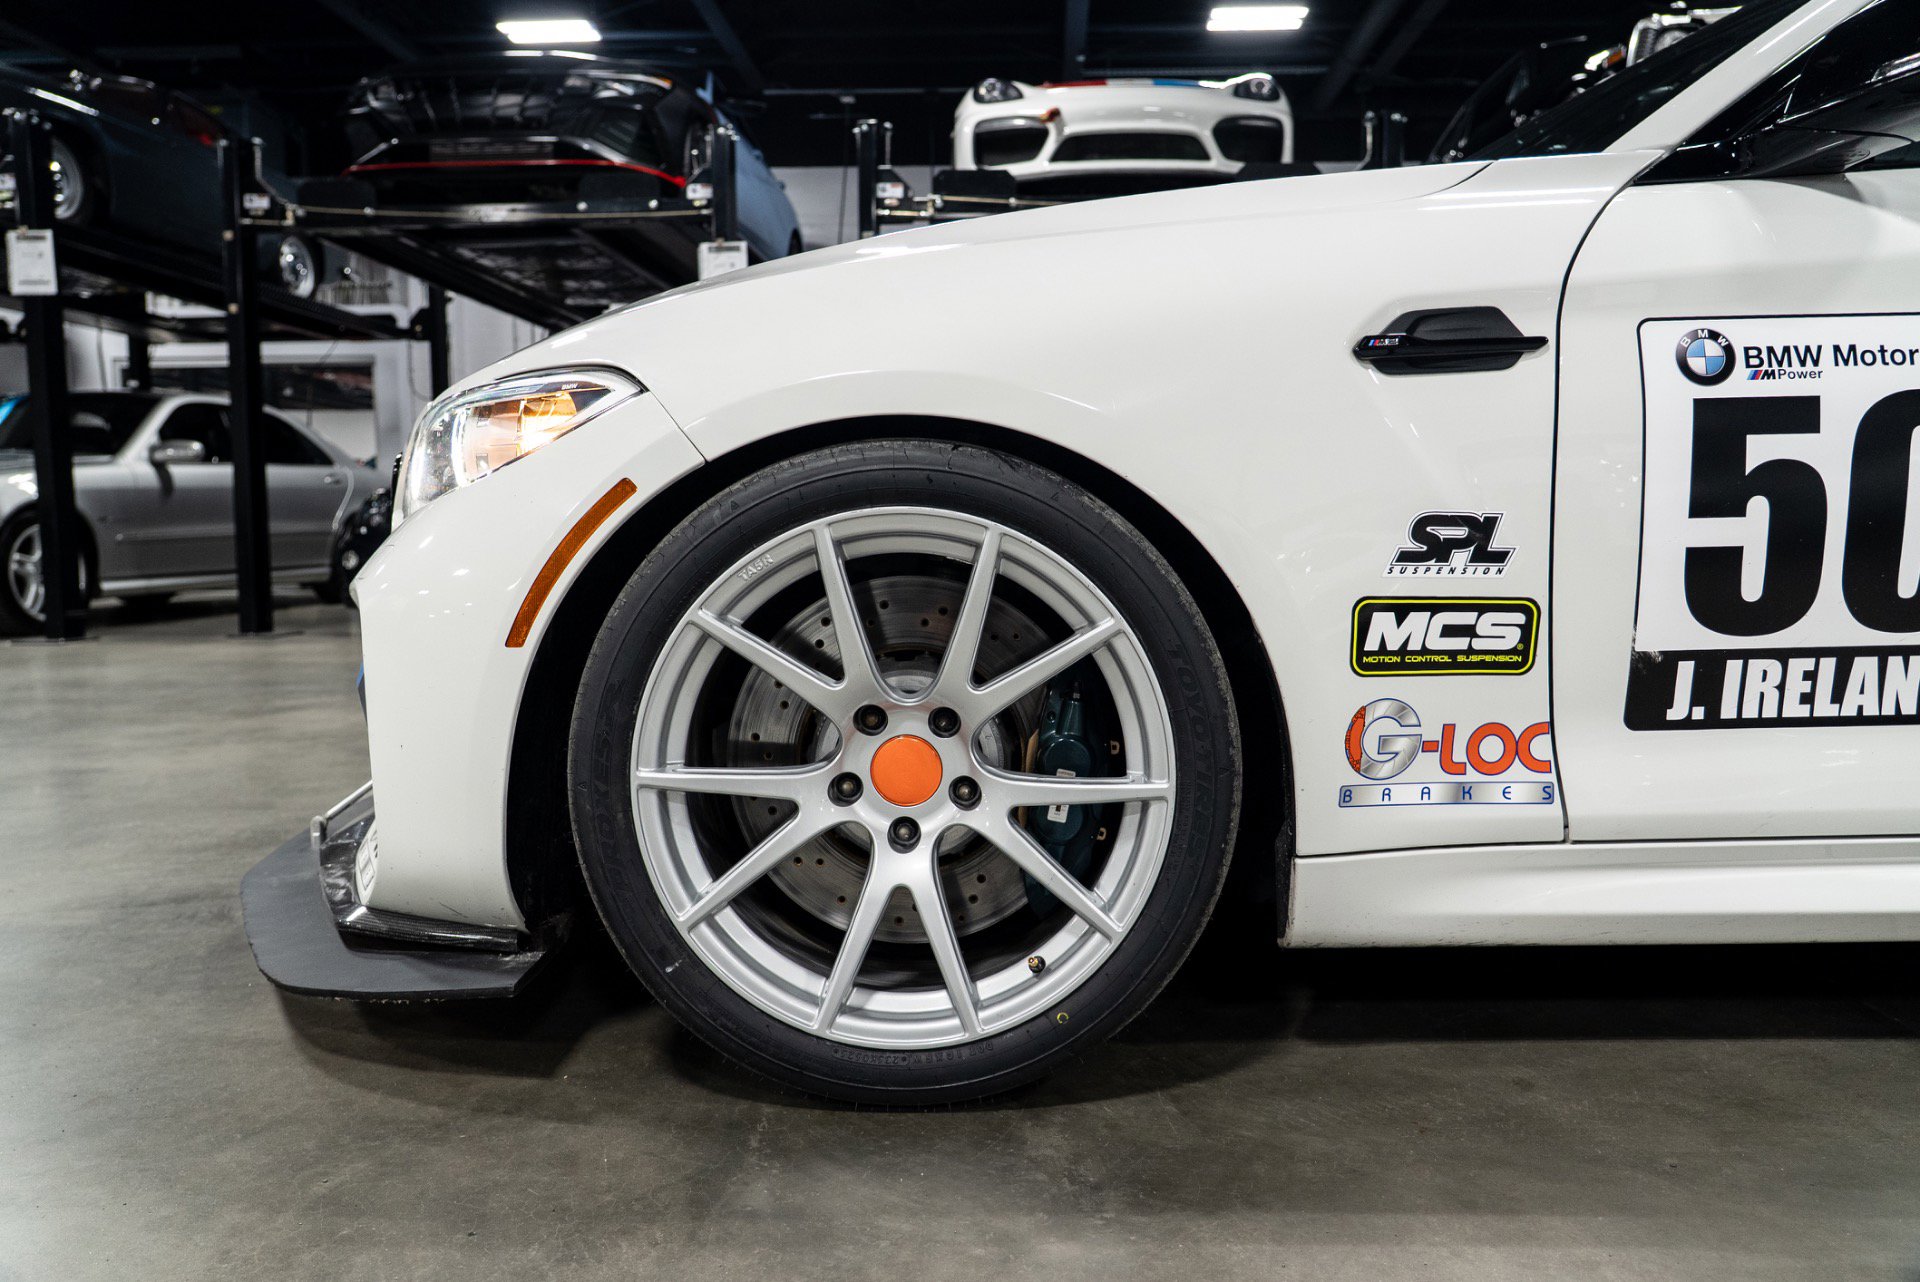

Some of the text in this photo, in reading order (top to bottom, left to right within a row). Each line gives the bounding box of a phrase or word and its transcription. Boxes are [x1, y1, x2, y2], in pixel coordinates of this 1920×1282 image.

[1681, 329, 1728, 347] BMW
[1743, 344, 1919, 369] BMW Motor
[1390, 511, 1516, 566] SPL
[1387, 566, 1504, 575] SUSPENSION
[1363, 611, 1526, 651] MCS
[1363, 655, 1401, 663] MOTION
[1666, 655, 1920, 721] J. IRELAN
[1345, 698, 1552, 780] G-LOC
[1342, 786, 1552, 803] BRAKES
